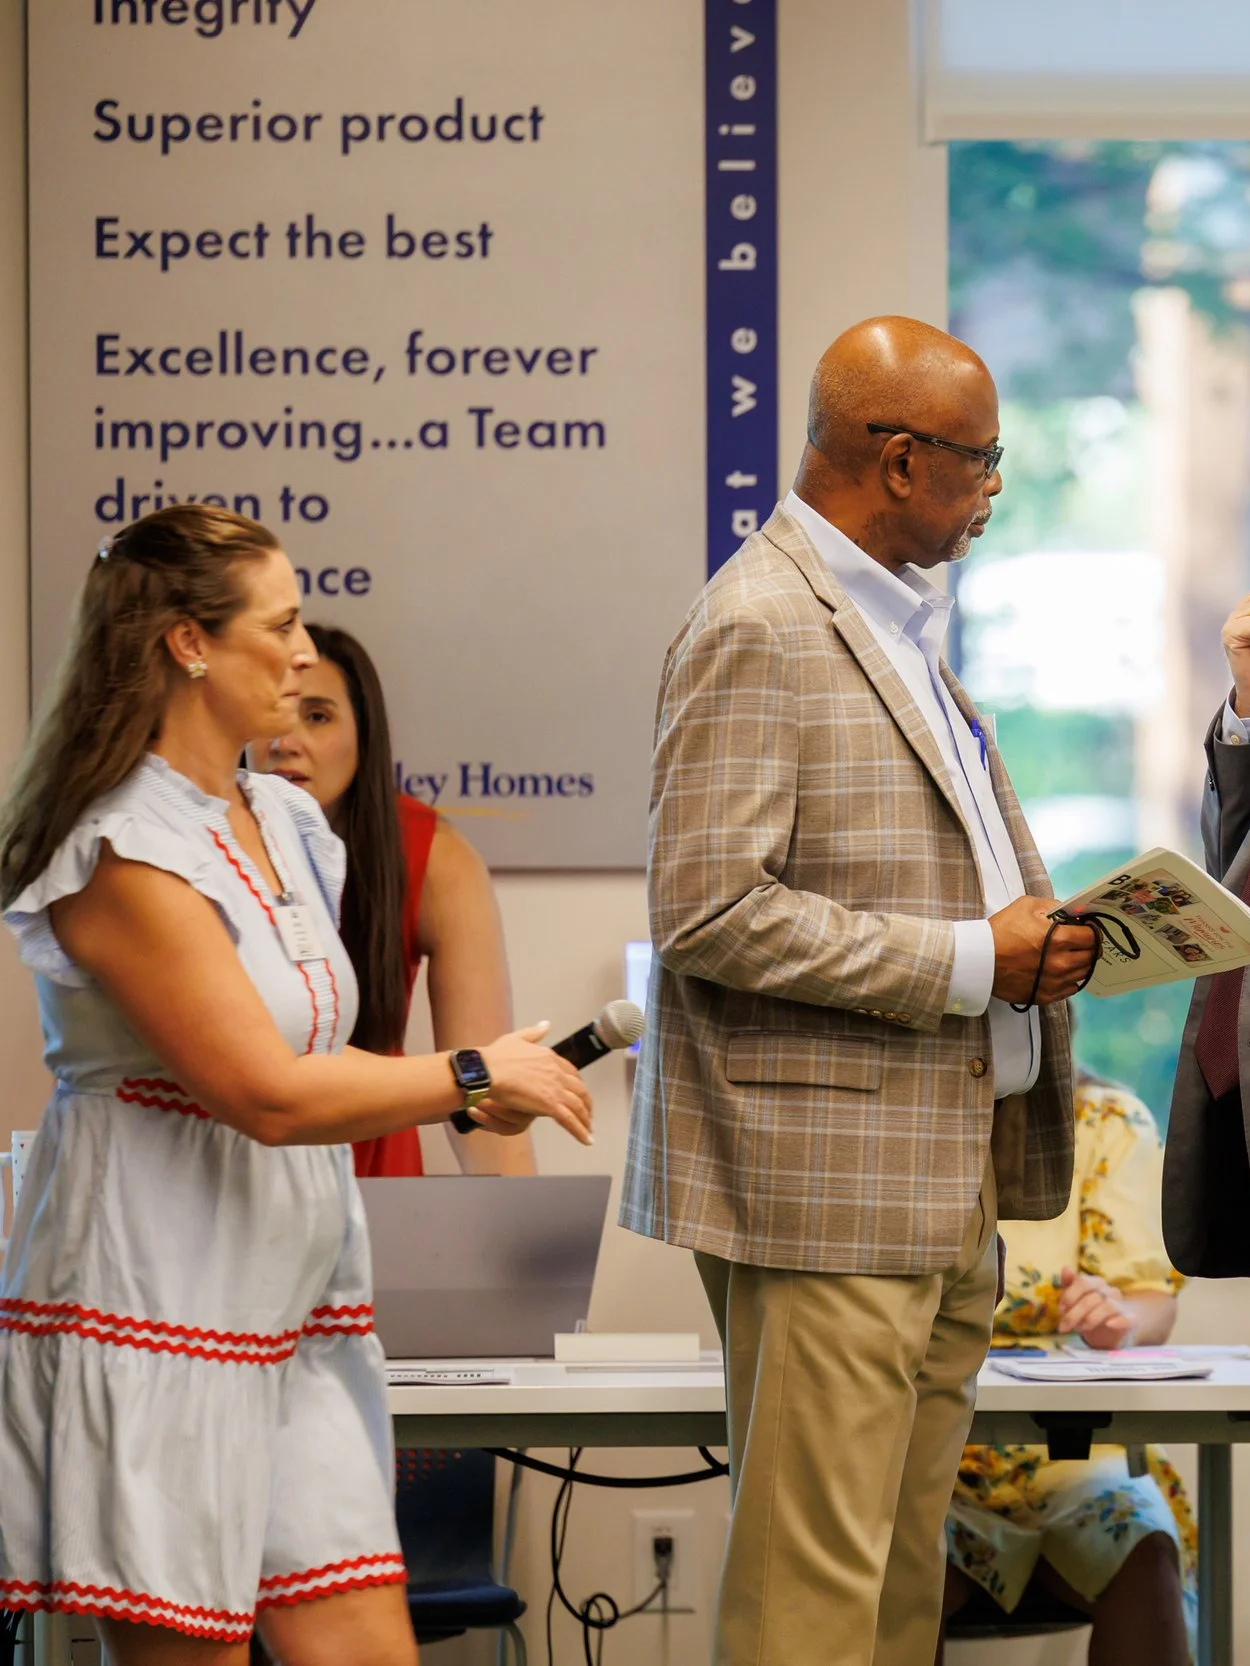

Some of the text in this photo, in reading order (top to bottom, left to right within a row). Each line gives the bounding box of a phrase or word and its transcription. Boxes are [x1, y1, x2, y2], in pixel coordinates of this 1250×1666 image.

[93, 97, 544, 155] Superior product
[718, 0, 757, 270] believ
[95, 213, 493, 272] Expect the best
[95, 330, 598, 383] Excellence, forever
[731, 327, 758, 418] we
[467, 407, 605, 449] Team
[279, 486, 329, 522] to
[457, 762, 594, 798] Homes
[1101, 940, 1132, 964] EARS
